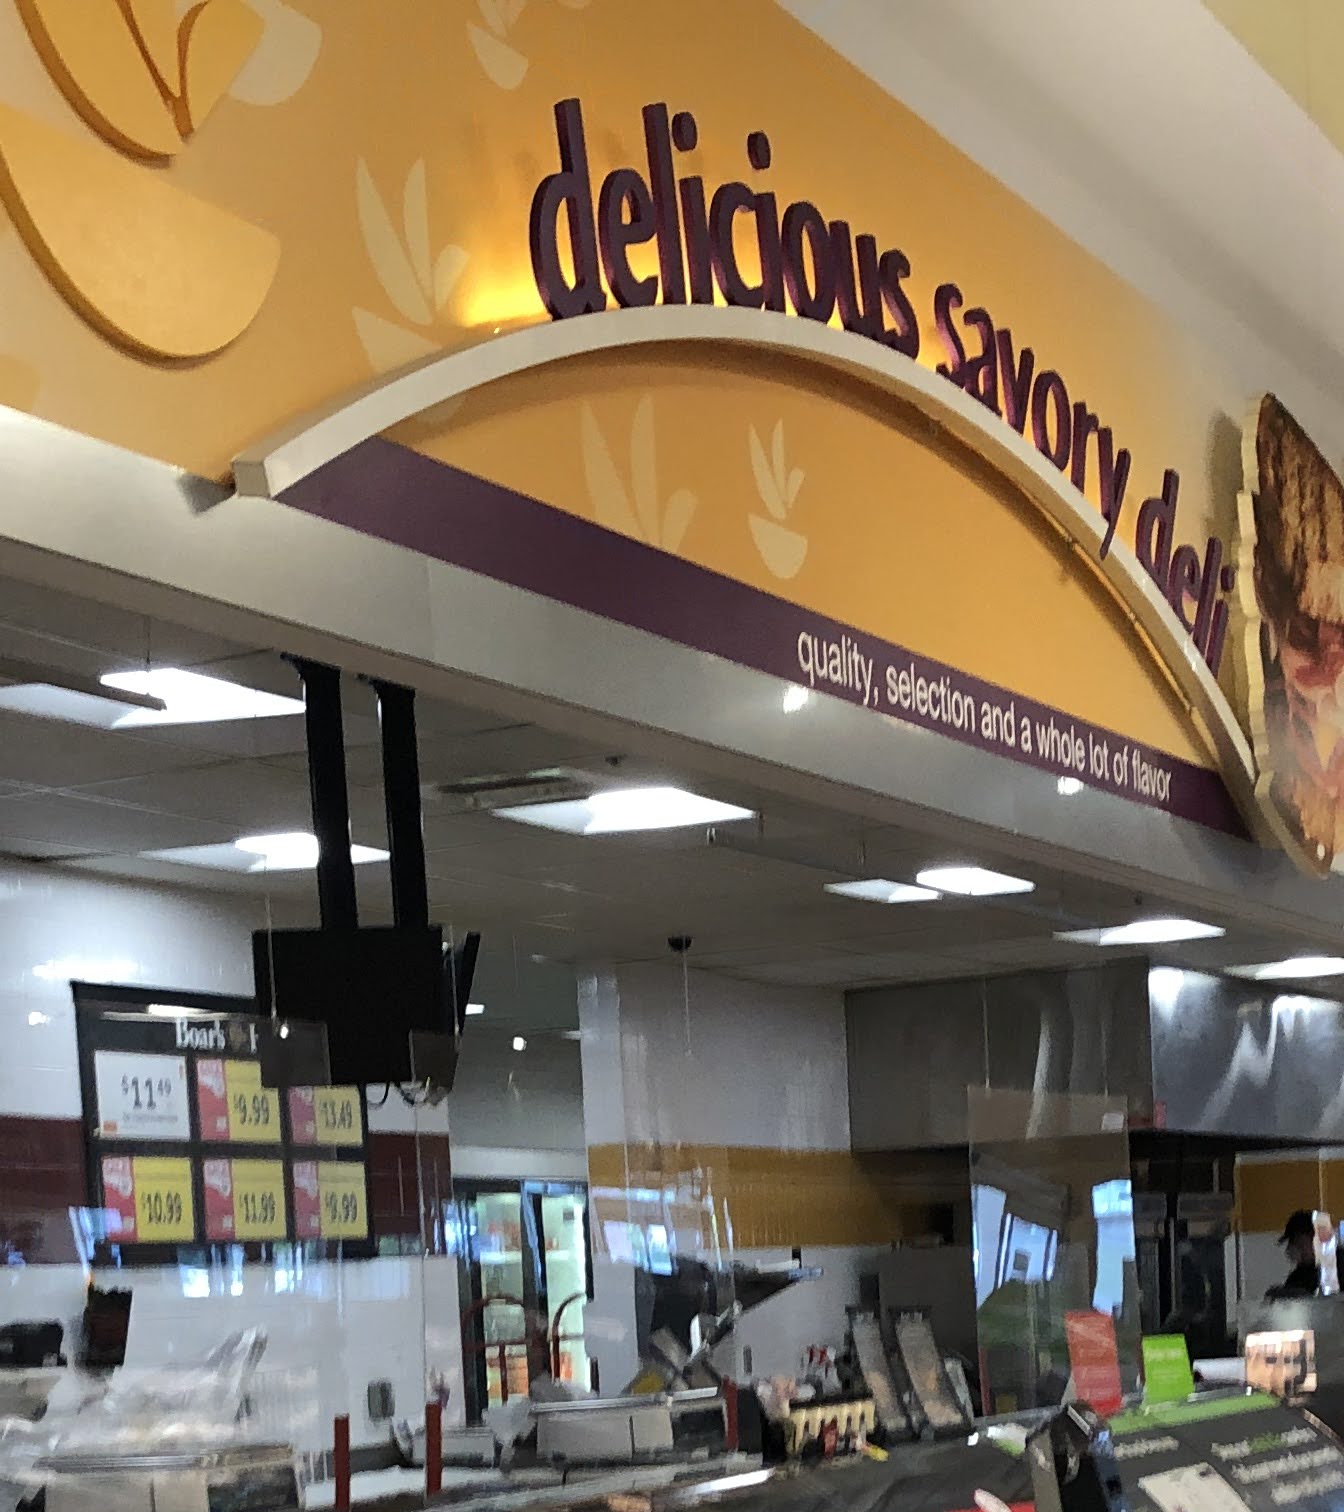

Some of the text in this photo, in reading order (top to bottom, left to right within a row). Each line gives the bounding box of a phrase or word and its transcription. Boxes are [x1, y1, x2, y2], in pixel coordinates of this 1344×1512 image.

[529, 97, 1237, 680] delicious savory deli
[796, 630, 1173, 802] quality, selection and a whole lot of flavor
